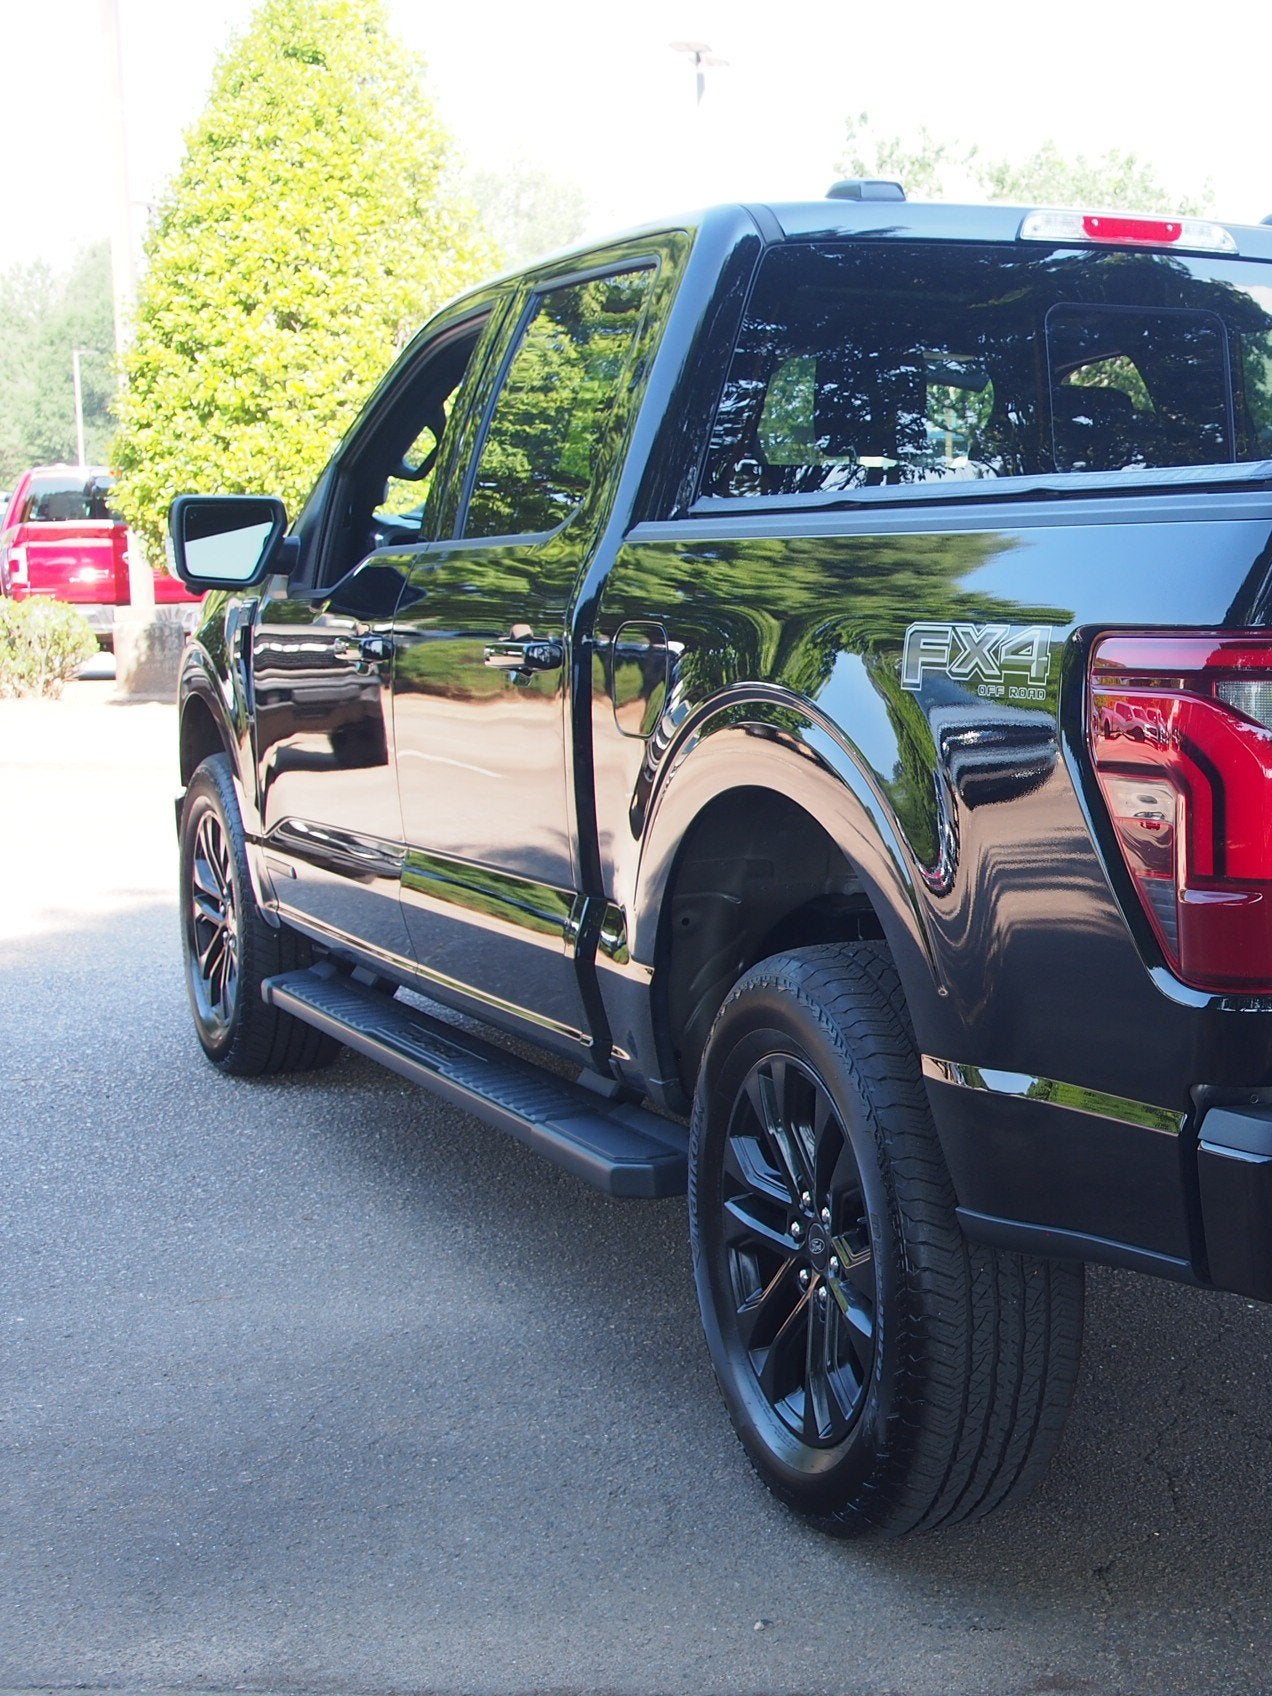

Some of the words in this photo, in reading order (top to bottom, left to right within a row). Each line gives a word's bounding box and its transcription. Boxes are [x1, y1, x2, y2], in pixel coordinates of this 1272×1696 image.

[901, 621, 1051, 691] FX4
[978, 684, 1004, 698] OFF
[1008, 687, 1047, 701] ROAD
